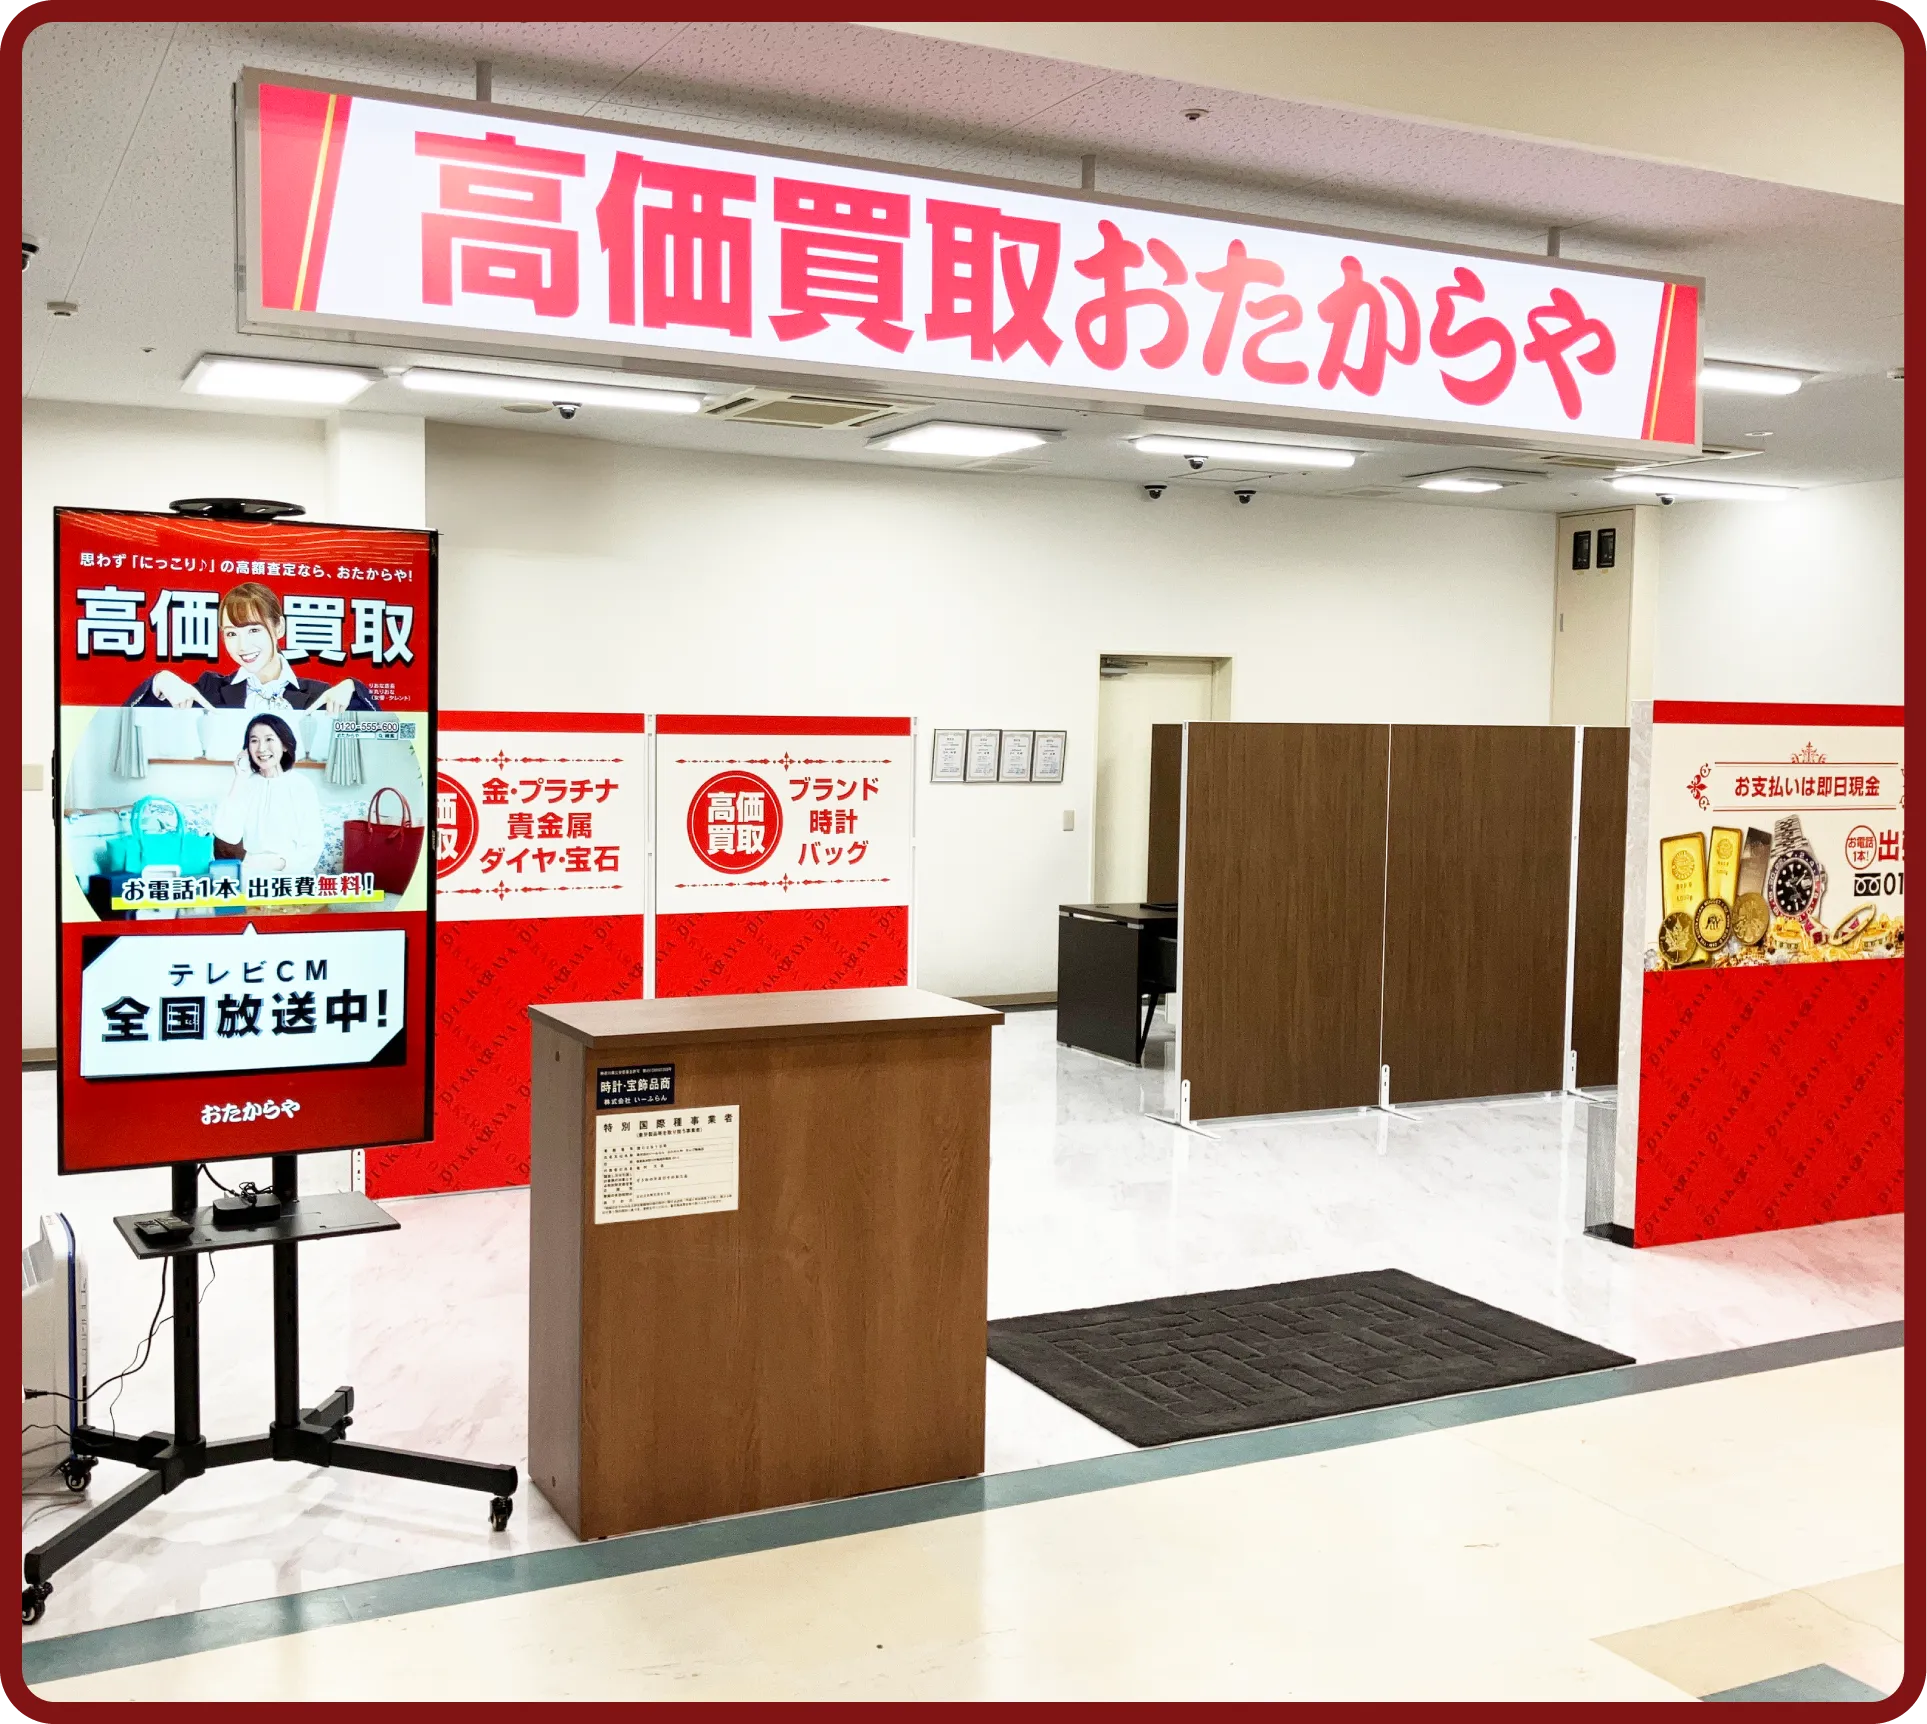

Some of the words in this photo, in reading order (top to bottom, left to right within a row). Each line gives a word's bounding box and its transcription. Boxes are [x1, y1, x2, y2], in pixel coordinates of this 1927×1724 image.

[334, 721, 398, 731] 0120-555-600
[481, 777, 619, 805] 金・プラチナ
[788, 776, 880, 803] ブランド
[1735, 775, 1881, 797] お支払いは即日現金
[706, 791, 766, 823] 高価
[507, 812, 593, 840] 貴金属
[809, 809, 859, 836] 時計
[706, 824, 766, 857] 買取
[797, 840, 870, 868] バッグ
[1848, 836, 1874, 849] お電話
[1878, 829, 1904, 862] 出
[479, 845, 620, 874] ダイヤ・宝石
[123, 878, 240, 901] お電話1本
[168, 959, 329, 987] テレビCM
[101, 988, 388, 1042] 全国放送中!
[600, 1076, 671, 1094] 時計・宝飾品商
[200, 1099, 302, 1126] おたからや
